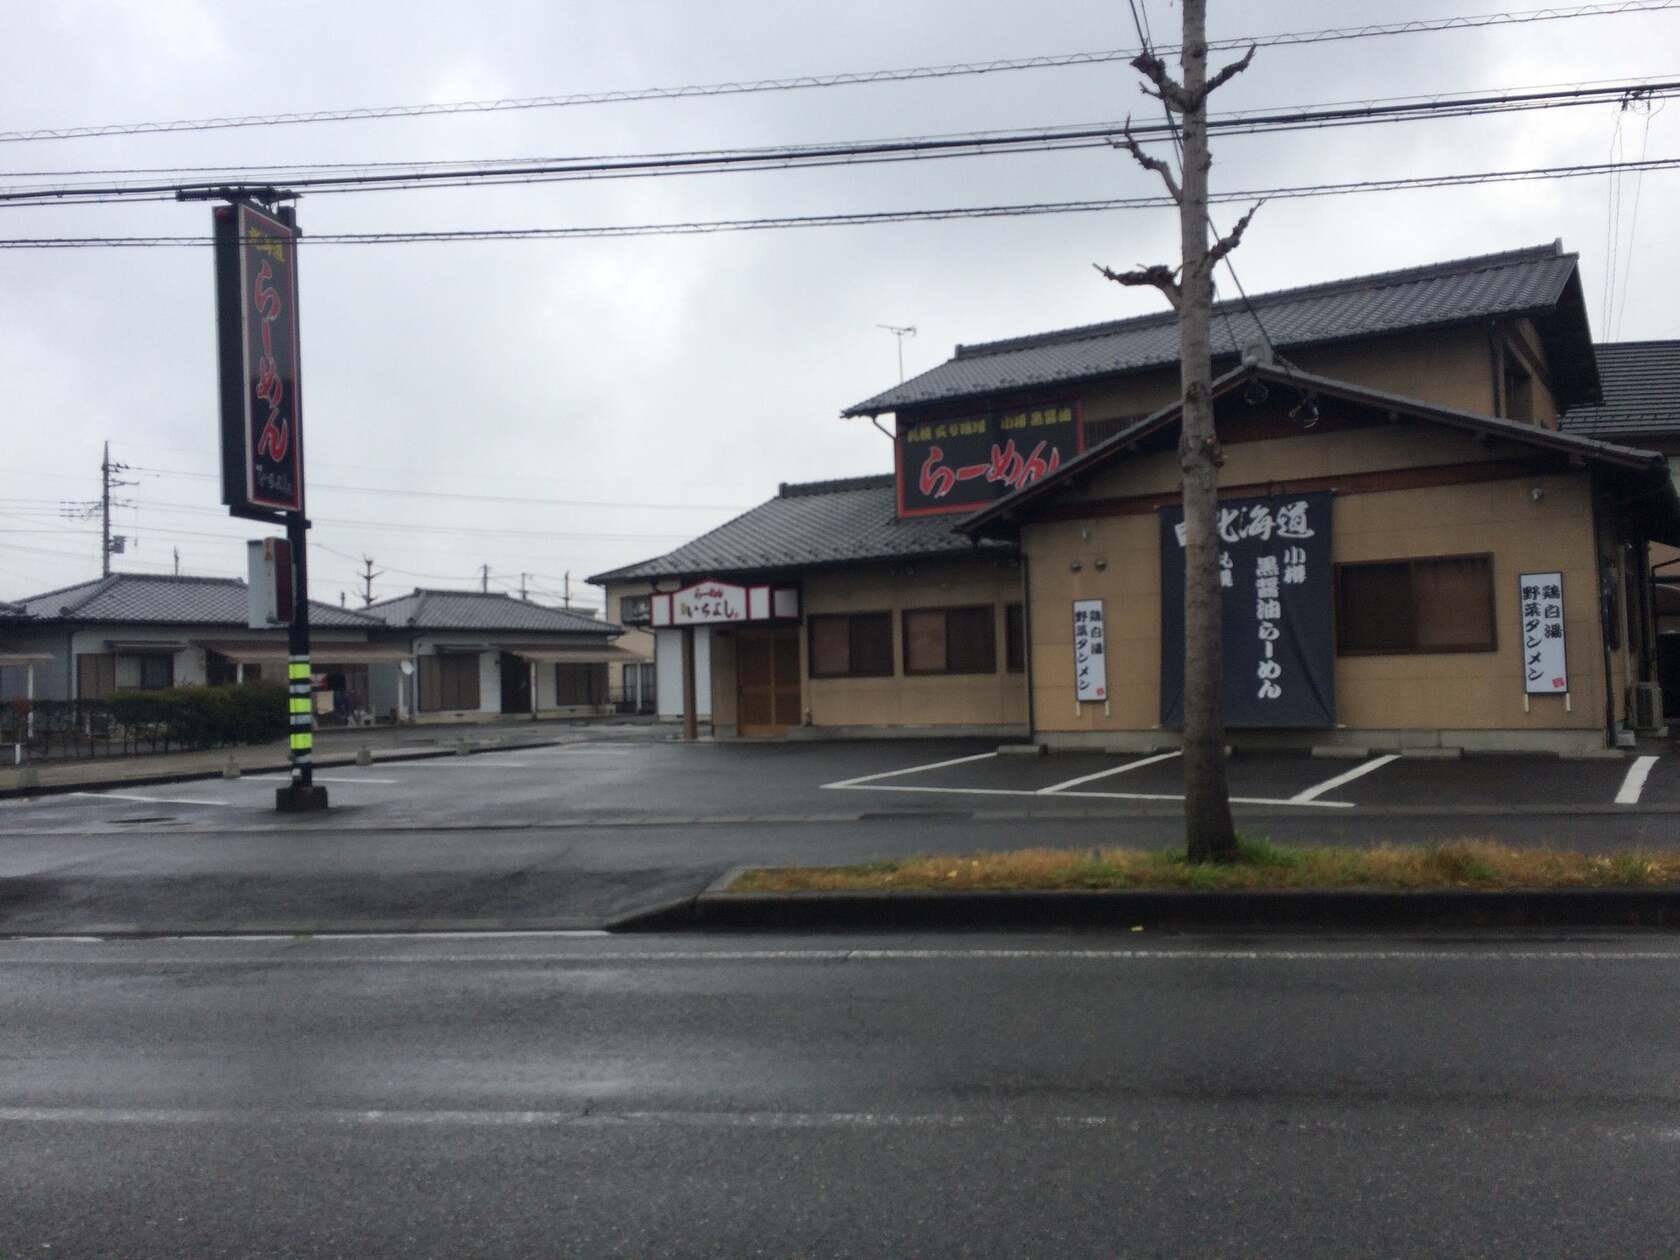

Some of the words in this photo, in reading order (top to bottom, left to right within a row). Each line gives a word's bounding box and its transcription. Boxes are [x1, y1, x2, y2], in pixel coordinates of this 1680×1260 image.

[1522, 585, 1545, 681] 野菜タンメン
